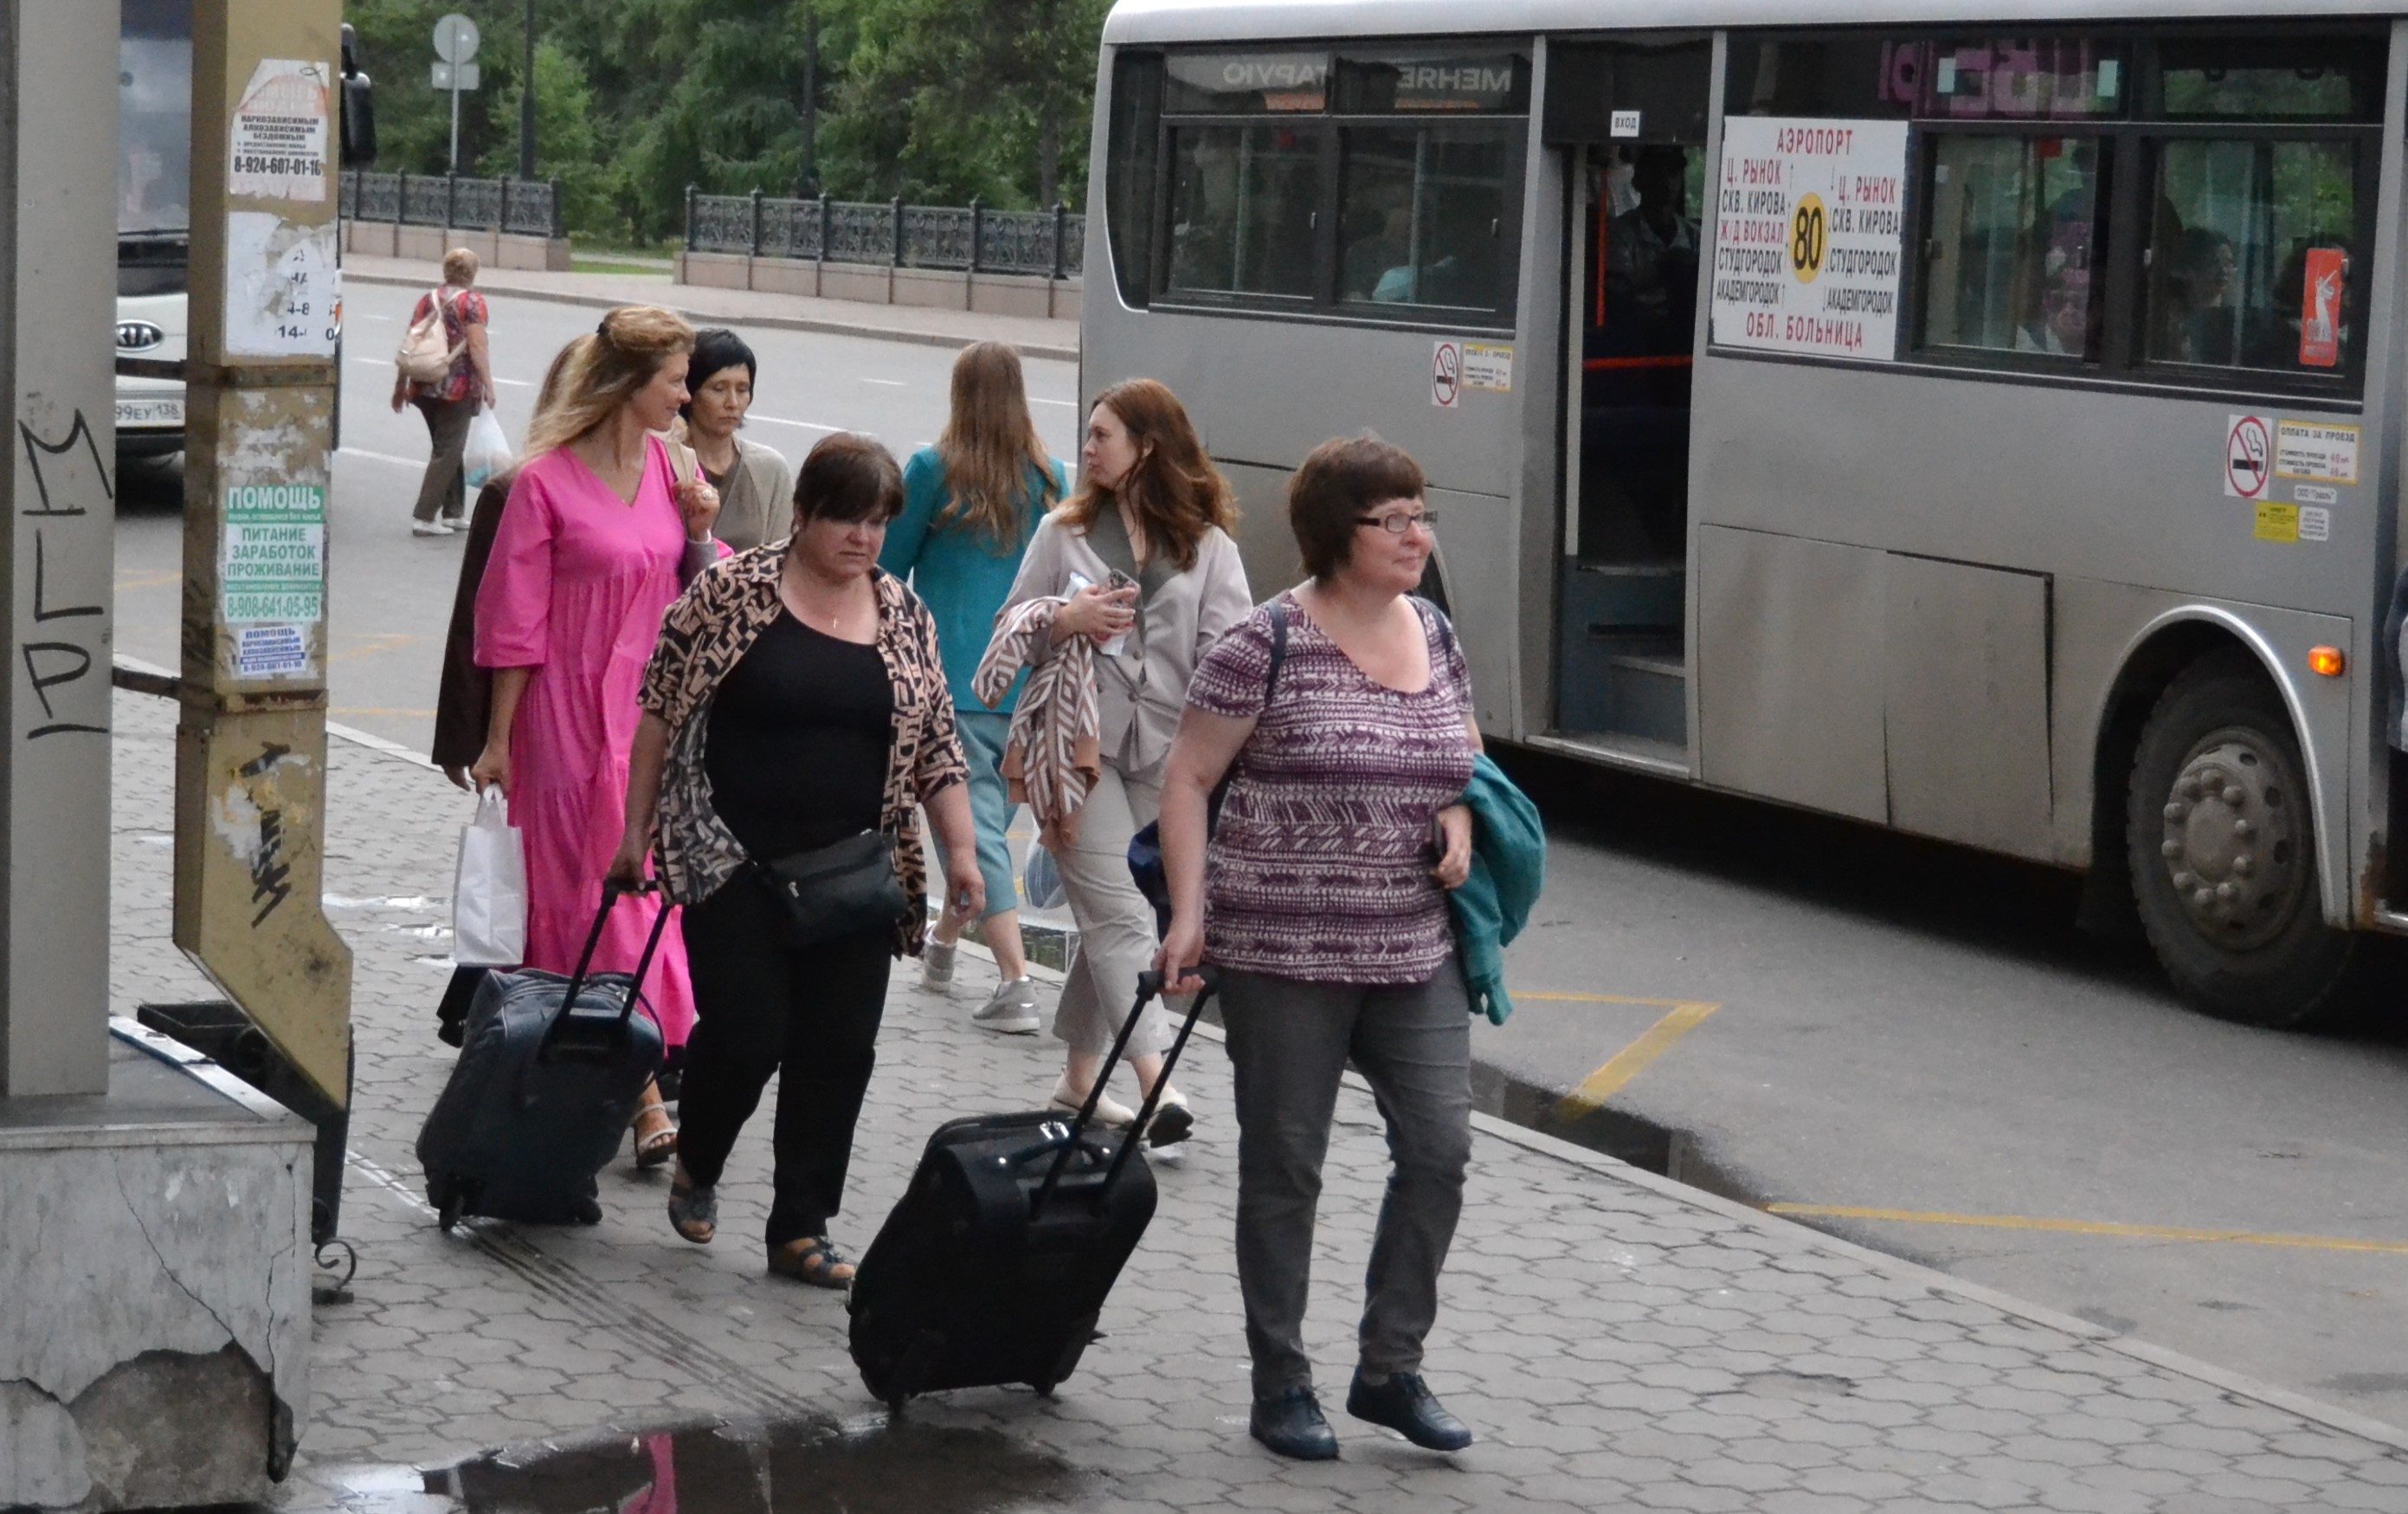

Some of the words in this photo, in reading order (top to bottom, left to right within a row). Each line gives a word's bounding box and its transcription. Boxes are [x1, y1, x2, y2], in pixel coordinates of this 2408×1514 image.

[1615, 117, 1636, 130] ВХОД
[1776, 127, 1853, 155] АЭРОПОРТ
[1727, 158, 1738, 187] Ц.
[1742, 158, 1782, 184] РЫНОК
[1722, 189, 1743, 213] СКВ.
[1747, 190, 1786, 216] КИРОВА
[1838, 176, 1850, 206] Ц.
[1856, 176, 1896, 203] РЫНОК
[1743, 220, 1784, 244] ВОКЗАЛ
[1832, 208, 1855, 233] СКВ.
[1858, 209, 1899, 235] КИРОВА
[1793, 206, 1823, 270] 80
[1718, 248, 1783, 275] СТУДГОРОДОК
[1829, 248, 1897, 280] СТУДГОРОДОК
[1716, 279, 1780, 308] АКАДЕМГОРОДОК
[1826, 287, 1894, 318] АКАДЕМГОРОДОК
[1746, 312, 1779, 339] ОБЛ.
[1786, 315, 1863, 351] БОЛЬНИЦА
[2280, 427, 2309, 437] ОПЛАТА
[2312, 429, 2322, 439] ЗА
[2325, 431, 2354, 442] ПРОЕЗД
[229, 486, 321, 511] ПОМОЩЬ
[242, 527, 306, 541] ПИТАНИЕ
[232, 544, 316, 559] ЗАРАБОТОК
[227, 563, 319, 577] ПРОЖИВАНИЕ
[227, 596, 319, 618] 8-908-641-05-95
[246, 628, 295, 639] ПОМОЩЬ
